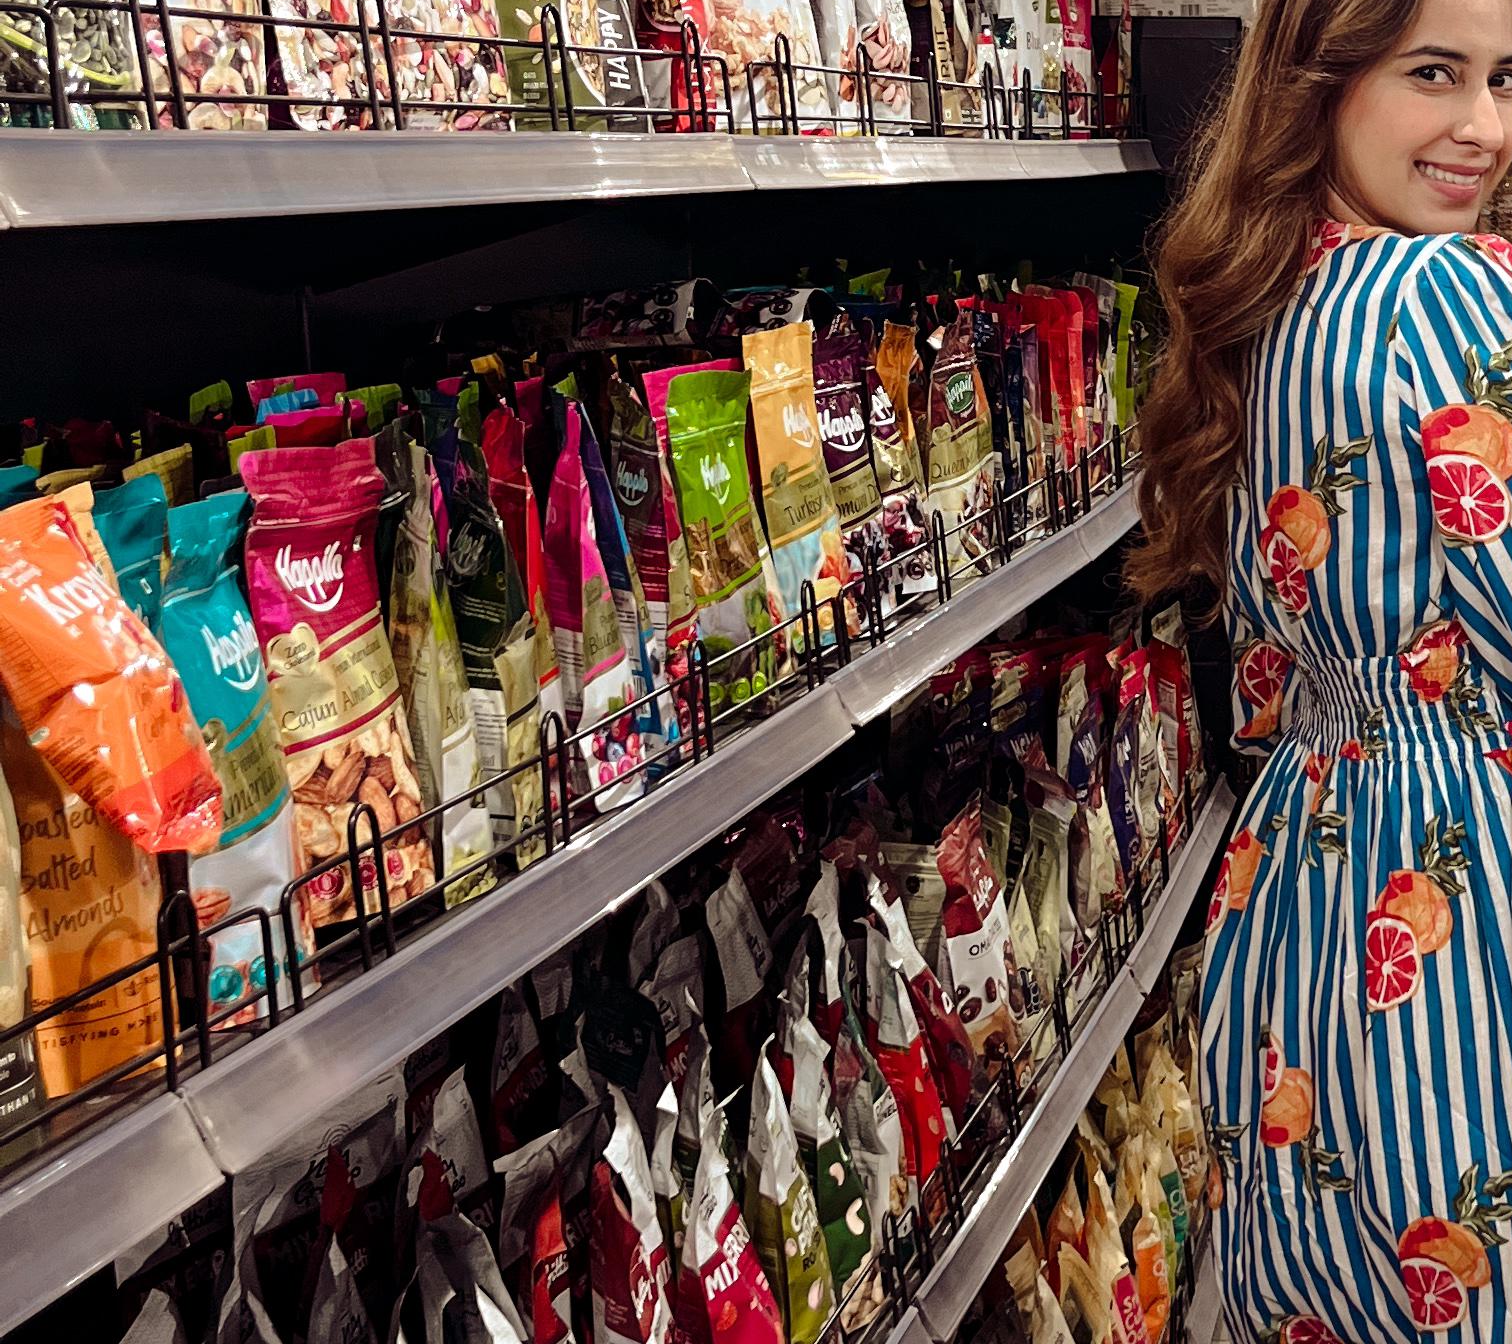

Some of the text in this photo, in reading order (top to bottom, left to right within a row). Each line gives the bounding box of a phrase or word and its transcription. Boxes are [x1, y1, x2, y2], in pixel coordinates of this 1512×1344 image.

[276, 540, 344, 602] Happilo
[281, 698, 339, 732] Cajun
[27, 889, 124, 944] Almonds
